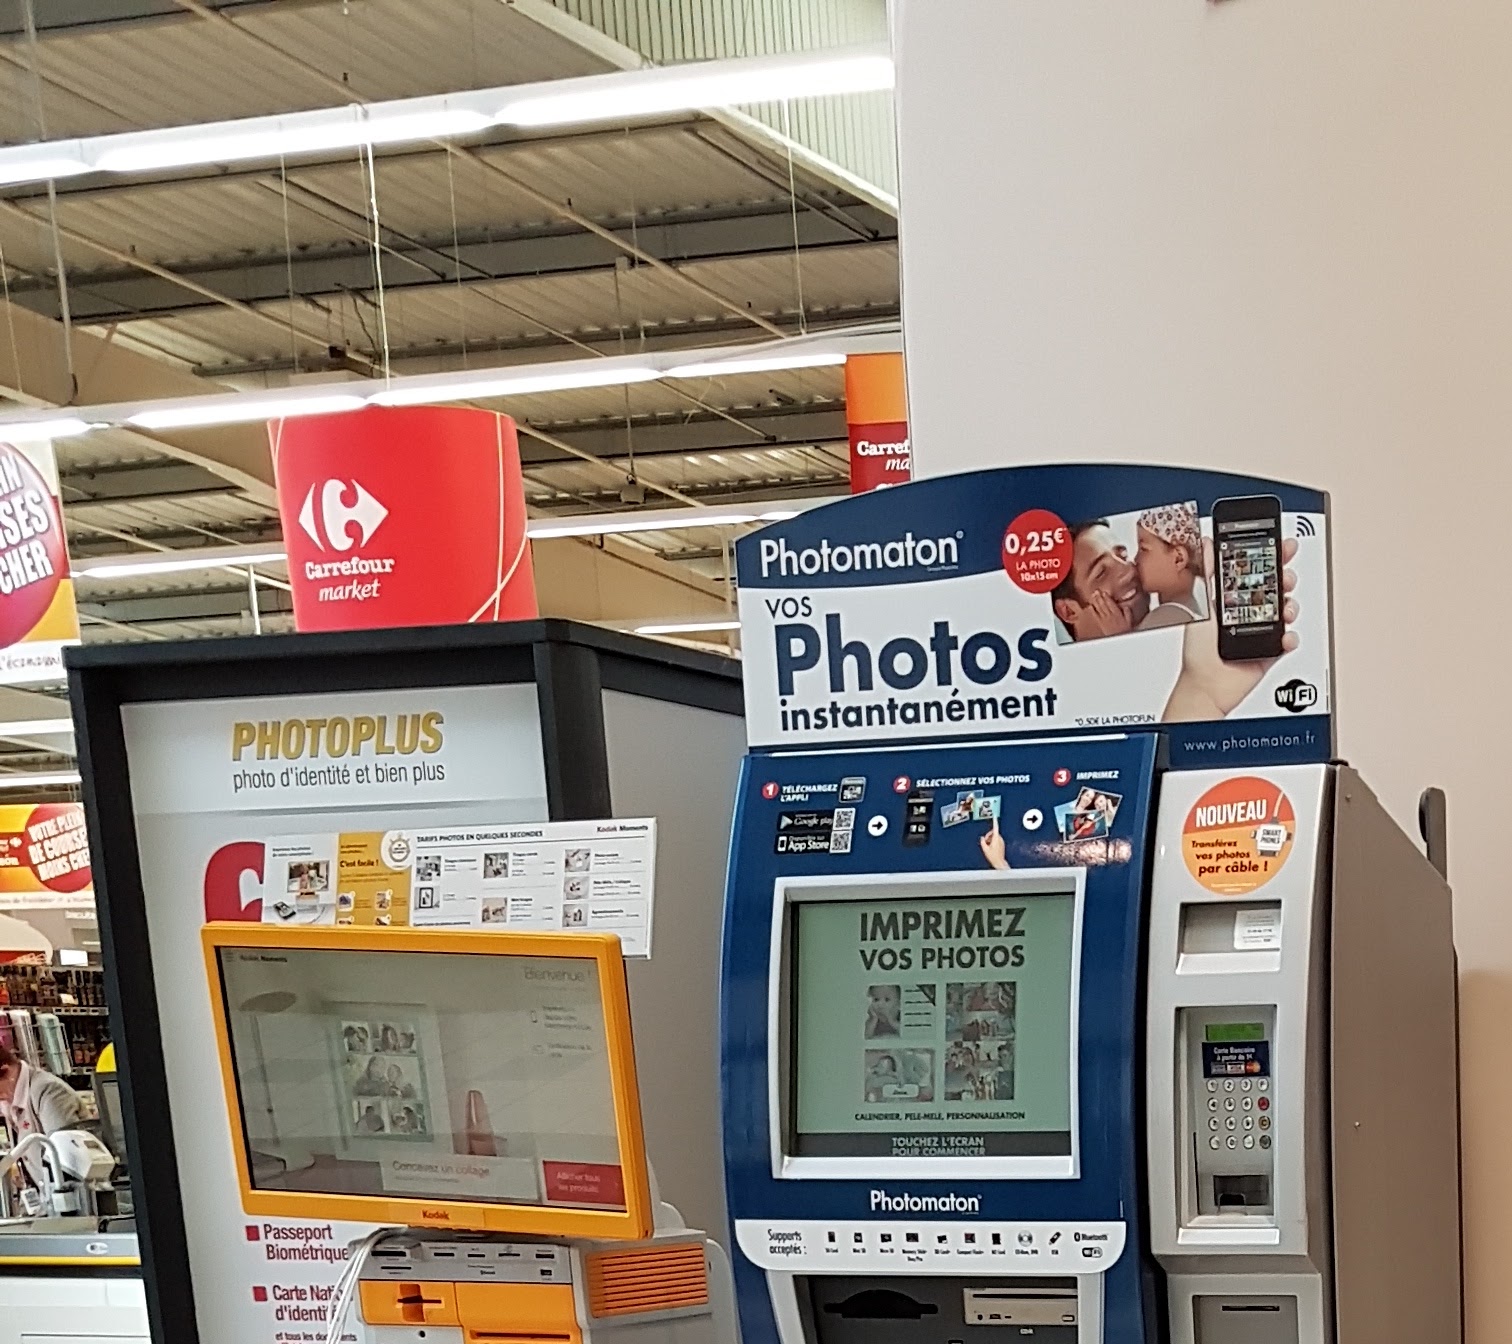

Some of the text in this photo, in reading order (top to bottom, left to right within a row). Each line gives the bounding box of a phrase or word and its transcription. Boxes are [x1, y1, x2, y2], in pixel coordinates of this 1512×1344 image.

[305, 556, 396, 580] Carrefour
[1016, 558, 1060, 571] LA PHOTO
[319, 579, 381, 601] market
[765, 596, 813, 619] VOS
[775, 612, 1053, 696] Photos
[780, 687, 1058, 731] instantanément
[232, 711, 444, 761] PHOTOPLUS
[233, 761, 445, 793] photo d'identité et bien plus
[916, 774, 1030, 788] SÉLECTIONNEZ VOS PHOTOS
[1076, 770, 1119, 780] IMPRIMEZ
[1195, 799, 1267, 828] NOUVEAU
[1262, 828, 1282, 836] SMART
[788, 840, 829, 852] App Store
[1191, 838, 1237, 848] Transférez
[1216, 850, 1250, 862] photos
[1198, 865, 1221, 877] par
[1225, 860, 1259, 873] câble
[859, 907, 1027, 942] IMPRIMEZ
[859, 944, 1025, 971] VOS PHOTOS
[892, 1137, 984, 1147] TOUCHEZ L'ECRAN
[892, 1148, 986, 1156] POUR COMMENCER
[422, 1209, 449, 1220] Kodak
[263, 1223, 332, 1243] Passeport
[767, 1228, 802, 1244] Supports
[266, 1243, 348, 1264] Biométrique
